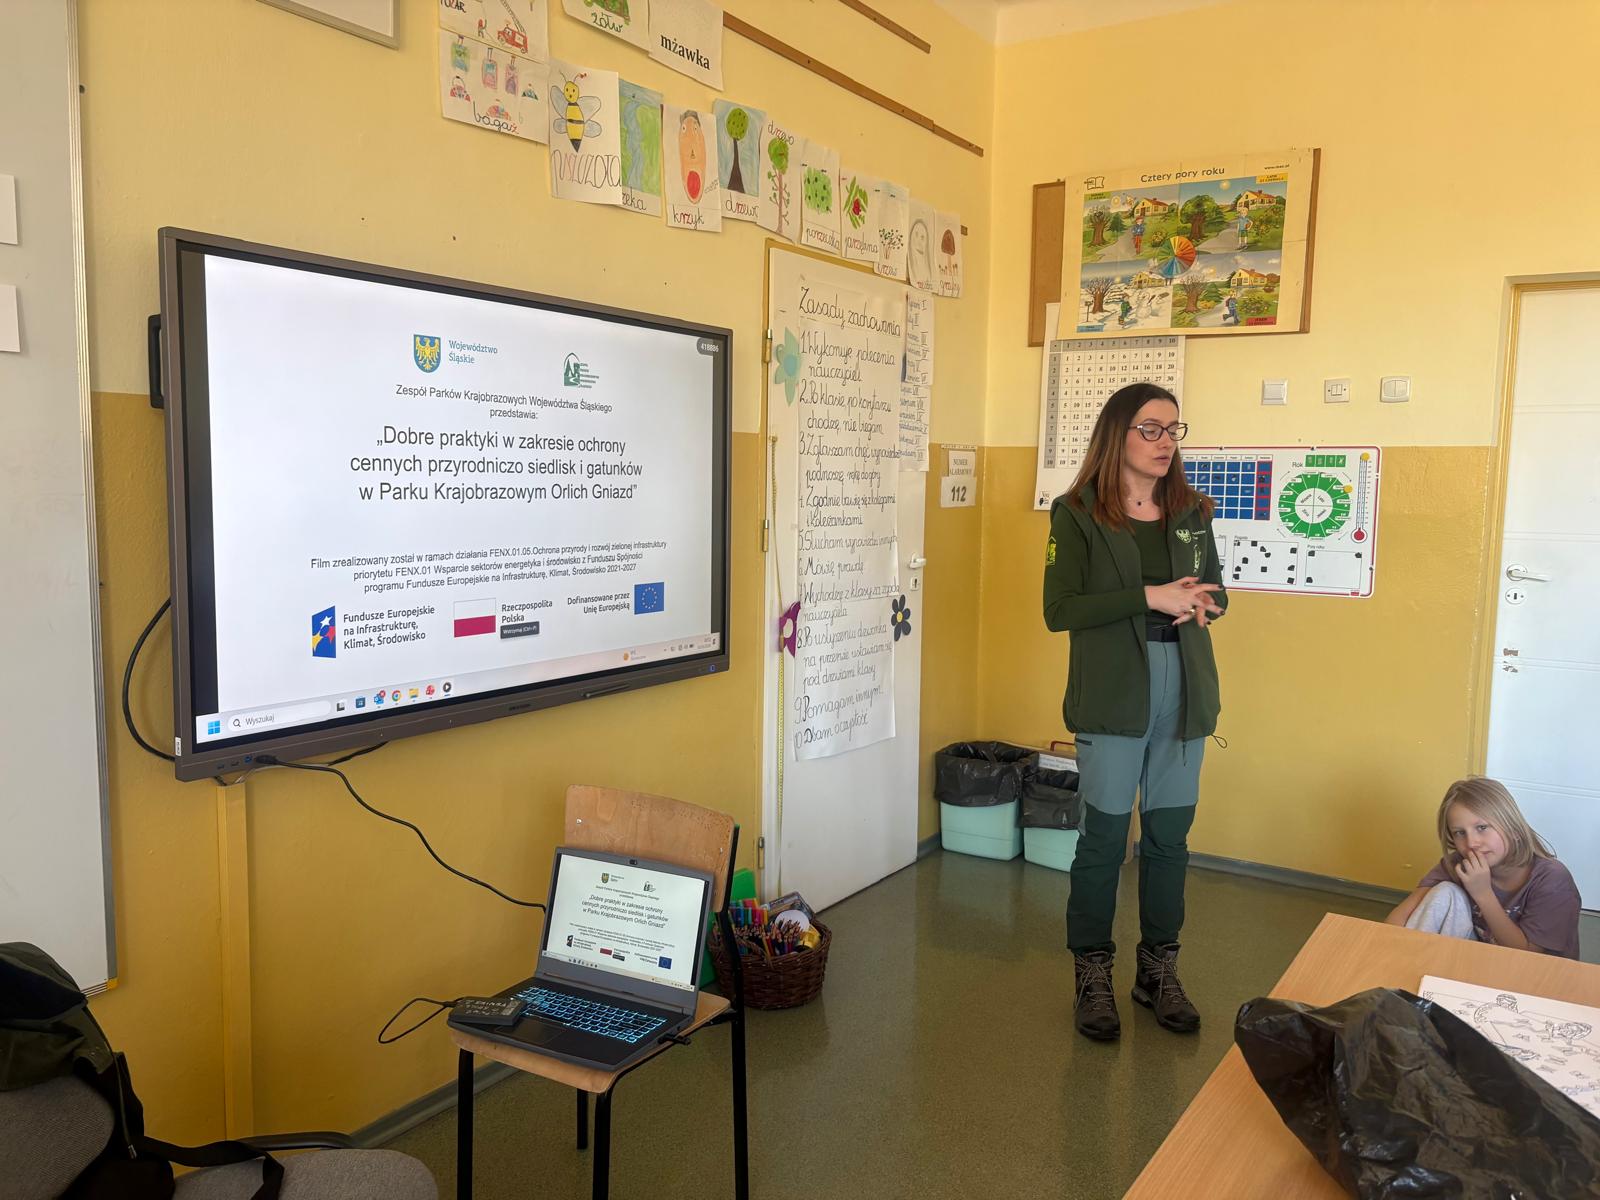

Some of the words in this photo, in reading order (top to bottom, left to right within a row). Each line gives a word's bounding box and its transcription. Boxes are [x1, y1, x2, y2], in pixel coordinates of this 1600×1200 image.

[660, 35, 711, 70] mżawka
[473, 101, 520, 133] bagaż
[1140, 173, 1172, 183] Cztery
[1175, 170, 1198, 179] pory
[1201, 167, 1225, 176] roku
[622, 187, 647, 210] zeka
[673, 204, 705, 230] krzyk
[799, 286, 845, 329] Zasady
[847, 301, 900, 336] zachowania
[448, 340, 499, 354] Województwo
[857, 338, 895, 370] polecenia
[448, 352, 475, 365] Śląskie
[396, 384, 427, 398] Zespół
[429, 386, 462, 399] Parków
[463, 390, 527, 406] Krajobrazowych
[529, 395, 578, 409] Województwa
[580, 399, 613, 414] Śląskiego
[490, 408, 538, 420] przedstawia:
[843, 419, 857, 432] nie
[376, 425, 434, 446] „Dobre
[440, 430, 498, 451] praktyki
[503, 436, 514, 448] w
[519, 434, 574, 451] zakresie
[578, 437, 626, 456] ochrony
[350, 454, 422, 476] cennych
[428, 457, 524, 477] przyrodniczo
[528, 458, 576, 474] siedlisk
[580, 460, 583, 474] i
[587, 461, 643, 479] gatunków
[806, 462, 845, 488] podnoszę
[359, 487, 374, 500] w
[380, 482, 428, 500] Parku
[434, 483, 546, 504] Krajobrazowym
[551, 483, 588, 500] Orlich
[806, 485, 841, 517] Zgodnie
[951, 485, 967, 502] 112
[311, 558, 331, 569] Film
[332, 556, 389, 568] zrealizowany
[390, 553, 415, 564] został
[425, 551, 454, 562] ramach
[455, 550, 488, 561] działania
[561, 545, 587, 554] przyrody
[591, 543, 610, 552] rozwój
[611, 542, 632, 551] zielonej
[633, 541, 667, 550] infrastruktury
[353, 568, 393, 581] priorytetu
[395, 566, 431, 577] FENX.01
[434, 564, 470, 576] Wsparcie
[471, 561, 502, 572] sektorów
[504, 558, 541, 571] energetyka
[546, 556, 581, 566] środowisko
[587, 554, 615, 563] Funduszu
[617, 552, 643, 562] Spójności
[364, 580, 404, 594] programu
[406, 577, 445, 589] Fundusze
[447, 574, 489, 586] Europejskie
[491, 574, 500, 582] na
[502, 570, 548, 581] Infrastrukturę,
[549, 568, 571, 577] Klimat,
[572, 565, 606, 576] Środowisko
[607, 563, 637, 573] 2021-2027
[501, 600, 553, 613] Rzeczpospolita
[567, 593, 613, 605] Dofinansowane
[614, 592, 630, 601] przez
[583, 605, 597, 614] Unię
[600, 602, 630, 612] Europejską
[343, 610, 385, 623] Fundusze
[387, 606, 435, 620] Europejskie
[501, 614, 525, 624] Polska
[343, 627, 354, 636] na
[356, 621, 419, 635] Infrastrukturę,
[344, 638, 376, 650] Klimat,
[377, 631, 426, 646] Środowisko
[803, 656, 816, 668] na
[803, 672, 820, 693] pod
[245, 713, 275, 726] Wyszukaj
